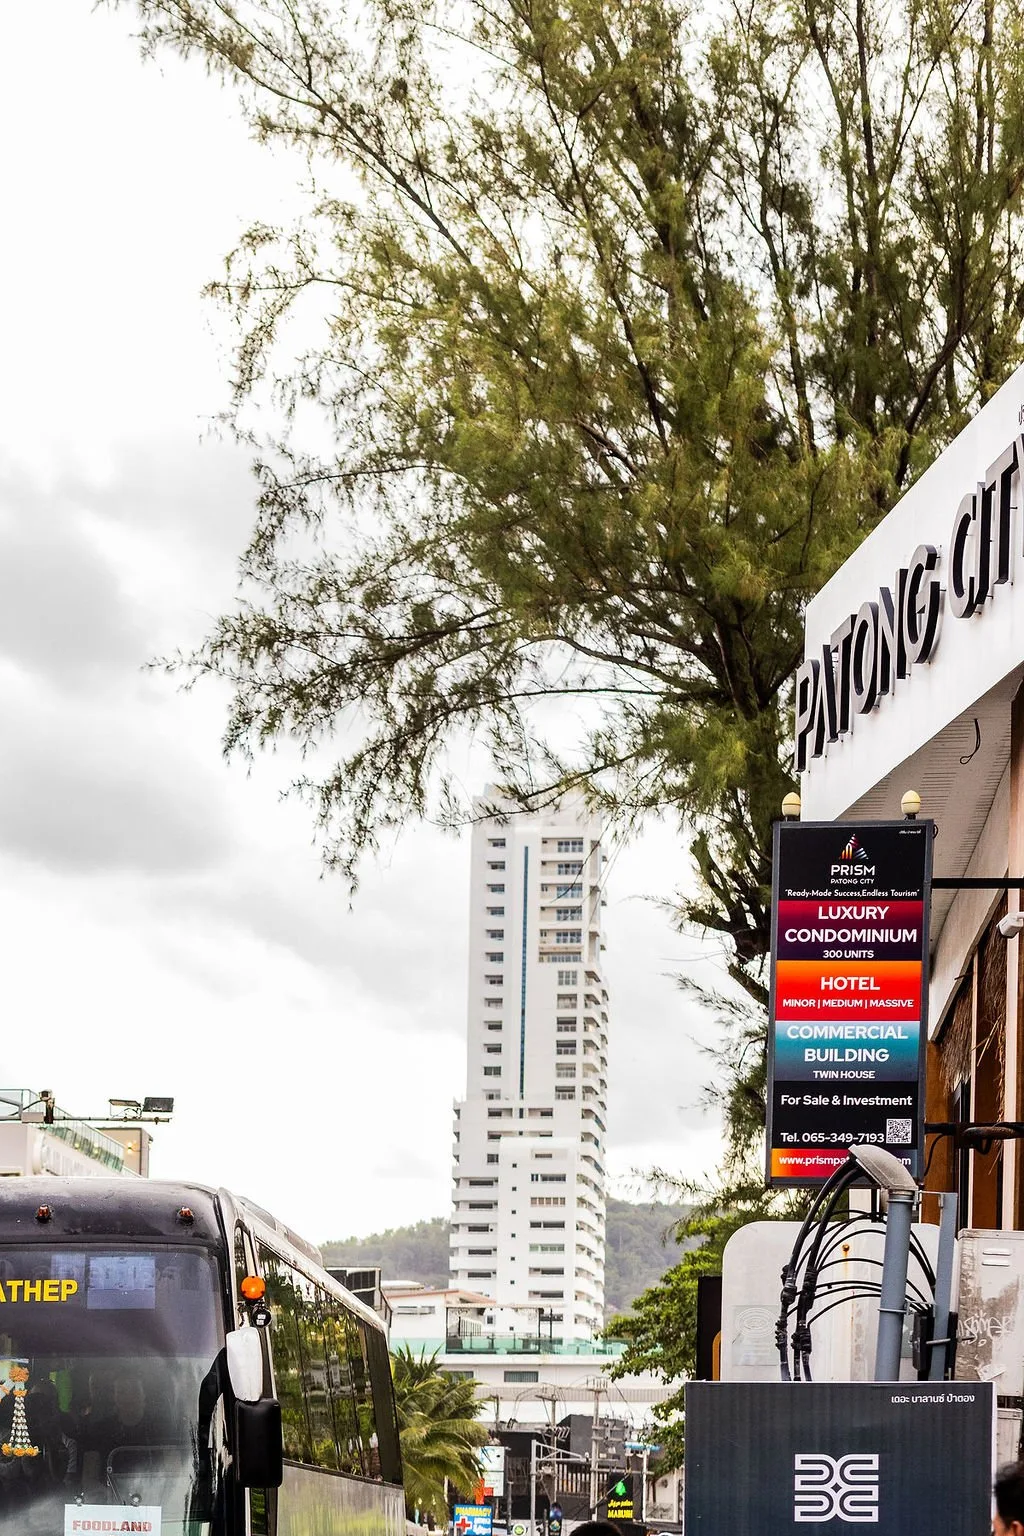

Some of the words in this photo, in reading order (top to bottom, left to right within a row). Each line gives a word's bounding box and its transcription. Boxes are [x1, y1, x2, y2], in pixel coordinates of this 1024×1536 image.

[794, 542, 942, 773] PATONG
[830, 865, 876, 876] PRISM
[818, 906, 889, 920] LUXURY
[784, 928, 917, 943] CONDOMINIUM
[823, 950, 843, 958] 300
[844, 950, 874, 958] UNITS
[820, 976, 881, 991] HOTEL
[782, 999, 816, 1007] MINOR
[822, 999, 863, 1007] MEDIUM
[869, 999, 914, 1007] MASSIVE
[787, 1025, 908, 1039] COMMERCIAL
[804, 1048, 890, 1062] BUILDING
[813, 1070, 839, 1079] TWIN
[840, 1070, 875, 1079] HOUSE
[781, 1095, 801, 1106] For
[803, 1095, 829, 1106] Sale
[831, 1095, 841, 1106] &
[843, 1095, 913, 1106] Investment
[780, 1132, 800, 1143] Tel.
[801, 1132, 885, 1143] 065-349-7193
[891, 1395, 910, 1404] เดอะ
[911, 1393, 945, 1404] บาลานซ์
[73, 1520, 152, 1533] FOODLAND
